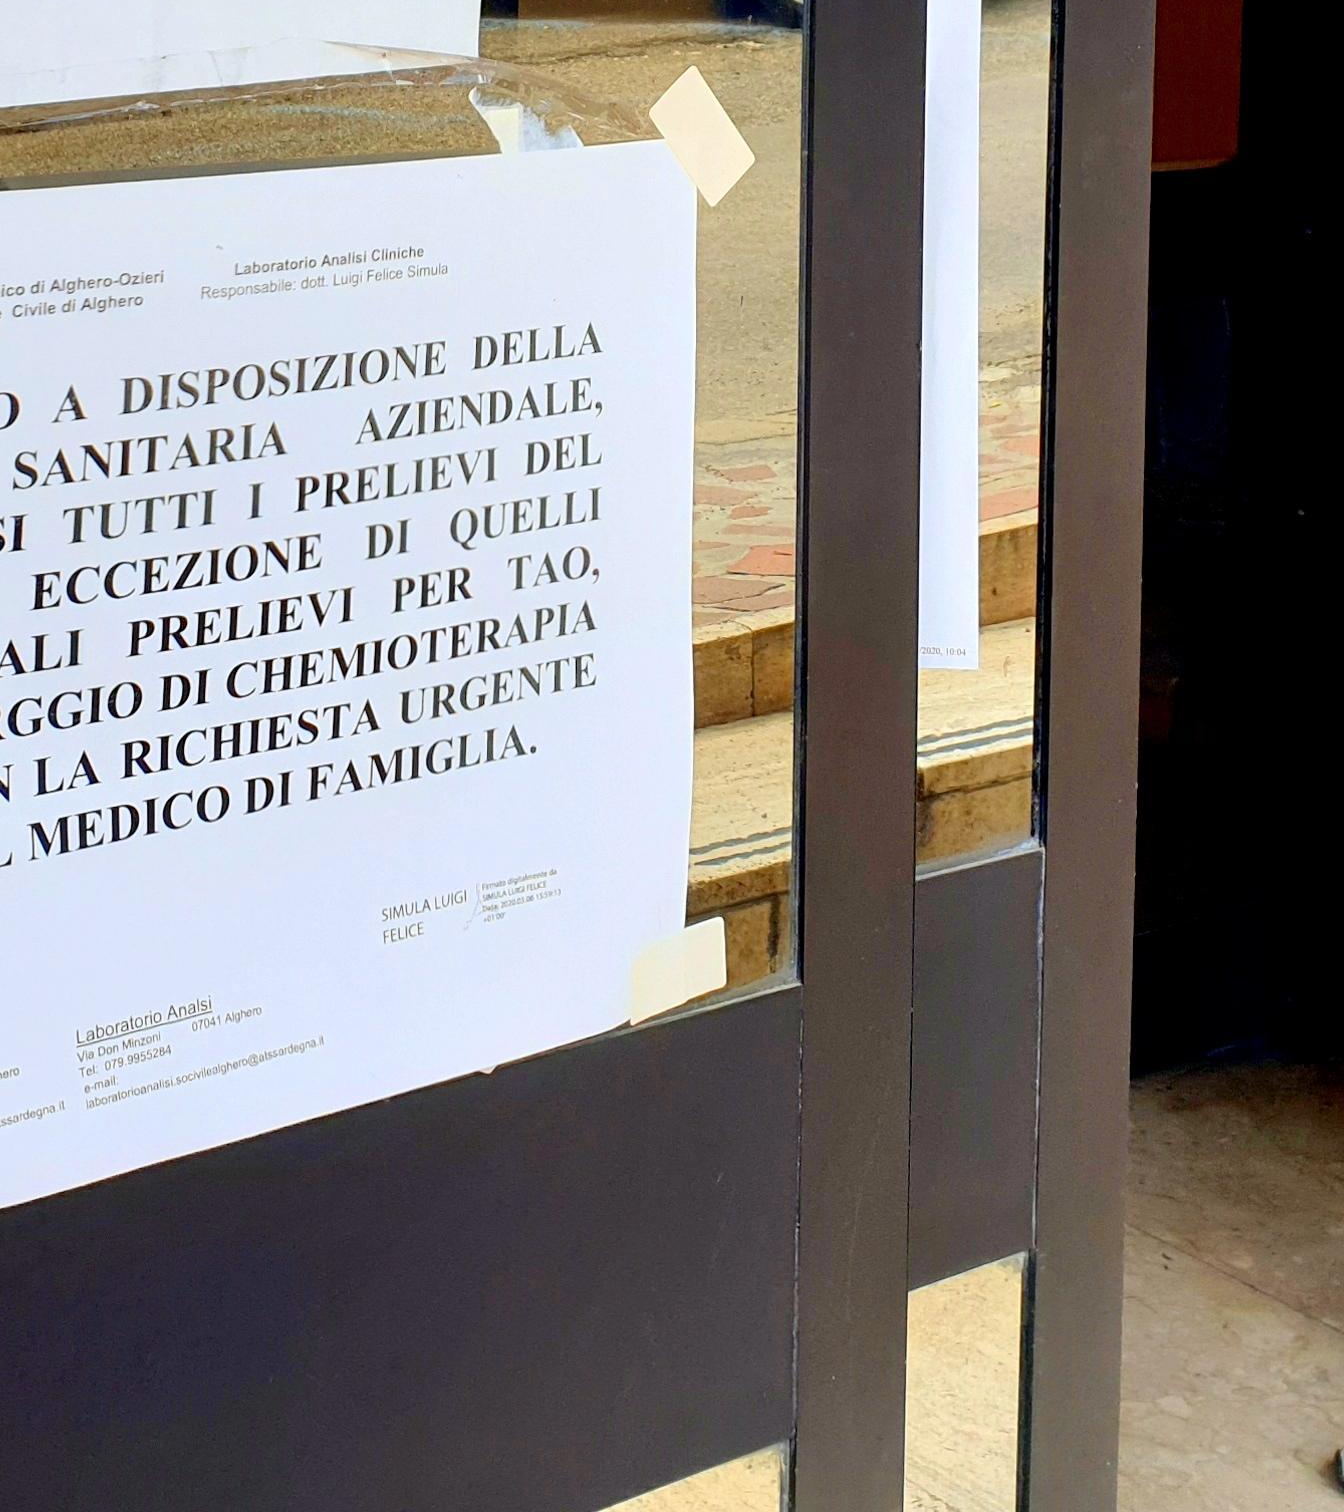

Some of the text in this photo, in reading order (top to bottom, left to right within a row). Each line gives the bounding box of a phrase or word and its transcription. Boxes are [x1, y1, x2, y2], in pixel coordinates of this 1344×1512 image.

[30, 280, 45, 294] di
[50, 270, 164, 294] Alghero-Ozieri
[200, 263, 448, 300] Responsabile: dott. Luigi Felice Simula
[234, 246, 424, 276] Laboratorio Analisi Cliniche
[12, 302, 56, 317] Civile
[62, 299, 75, 313] di
[81, 294, 144, 311] Alghero
[52, 385, 87, 423] A
[121, 340, 447, 415] DISPOSIZIONE
[472, 322, 603, 371] DELLA
[12, 421, 288, 491] SANITARIA
[356, 378, 604, 445] AZIENDALE,
[63, 489, 219, 544] TUTTI
[248, 483, 265, 520] I
[295, 447, 498, 514] PRELIEVI
[526, 433, 602, 476] DEL
[31, 534, 323, 611] ECCEZIONE
[366, 519, 412, 560] DI
[450, 487, 602, 551] QUELLI
[126, 587, 356, 658] PRELIEVI
[391, 566, 473, 614] PER
[508, 545, 600, 590] TAO,
[157, 668, 209, 713] DI
[226, 600, 597, 699] CHEMIOTERAPIA
[33, 750, 101, 797] LA
[121, 699, 380, 780] RICHIESTA
[400, 653, 597, 725] URGENTE
[27, 785, 230, 861] MEDICO
[244, 771, 295, 815] DI
[306, 724, 537, 802] FAMIGLIA.
[381, 890, 467, 922] SIMULA LUIGI
[383, 922, 424, 944] FELICE
[76, 996, 212, 1045] Laboratorio Analsi
[77, 1006, 263, 1063] Via Don Minzoni 07041 Alghero
[84, 1075, 119, 1094] e-mail:
[105, 1045, 172, 1071] 079.9955284
